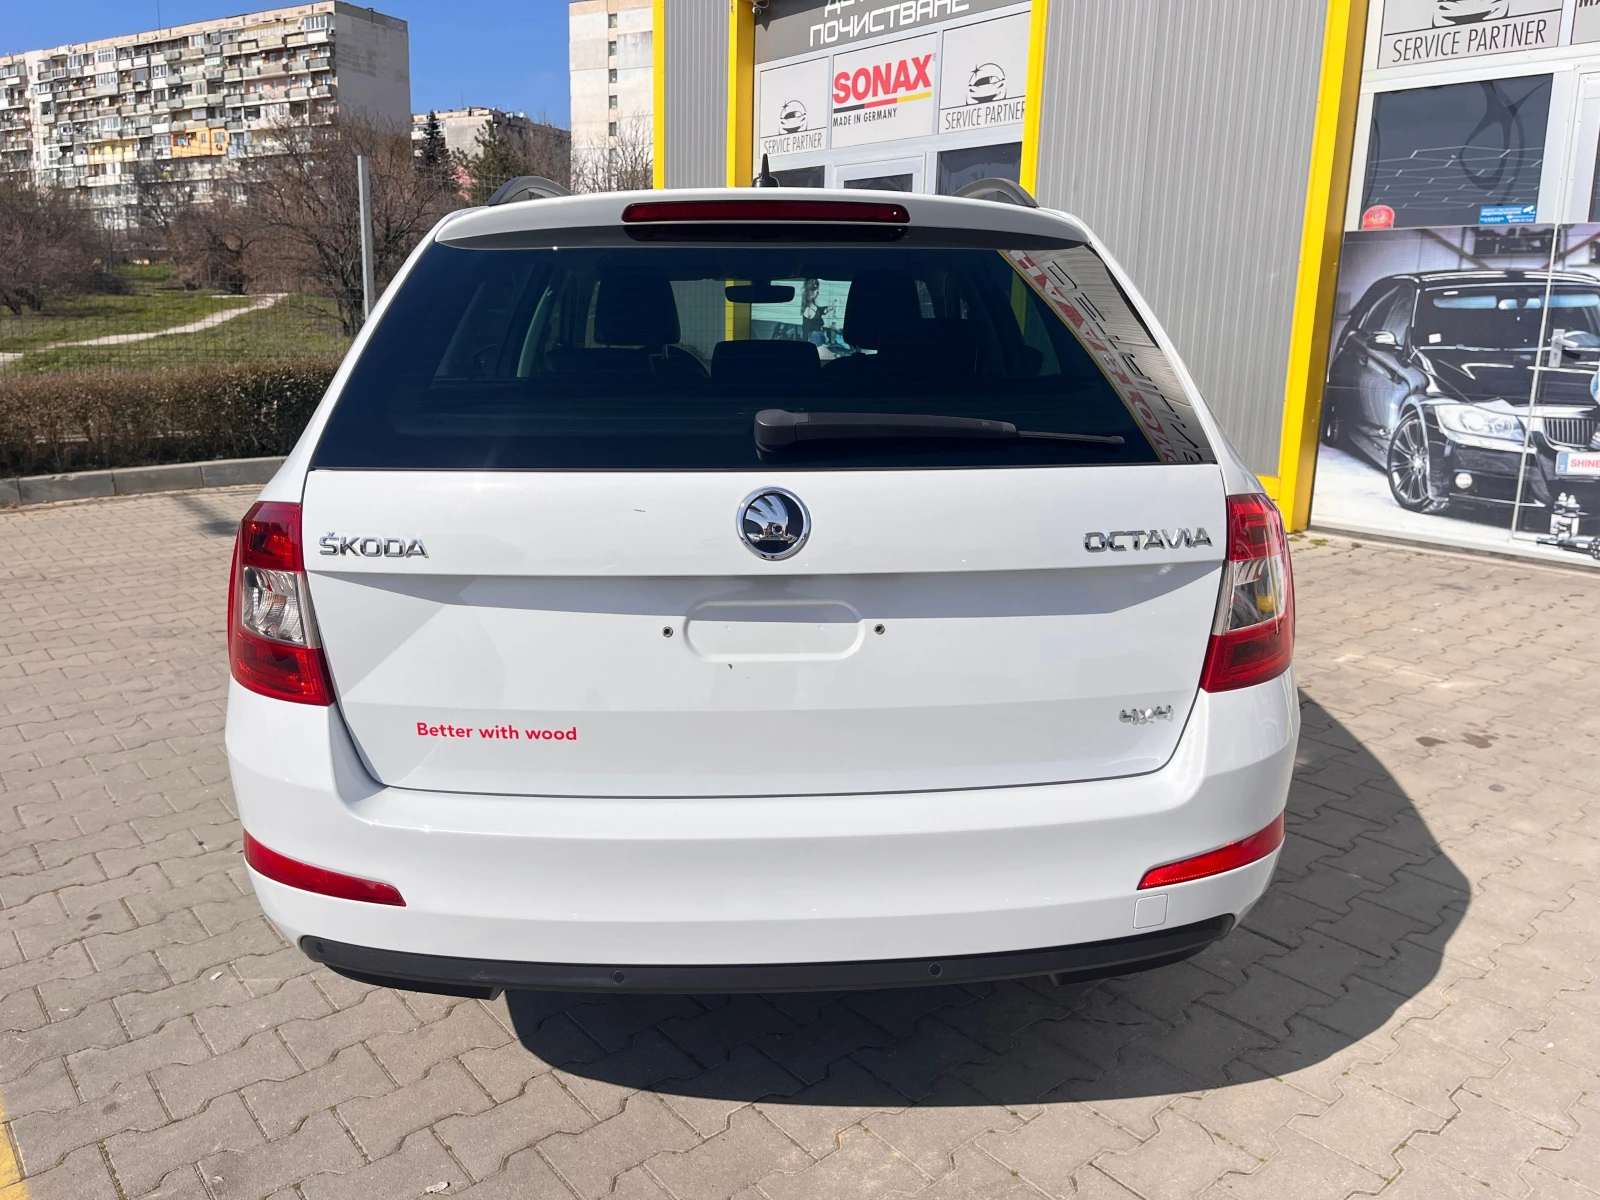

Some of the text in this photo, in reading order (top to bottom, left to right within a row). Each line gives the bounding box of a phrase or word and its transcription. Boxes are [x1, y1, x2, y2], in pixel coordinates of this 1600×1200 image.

[1392, 19, 1547, 63] SERVICE PARTNER
[833, 53, 933, 104] SONAX
[832, 107, 898, 127] MADE IN GERMANY
[945, 103, 982, 130] SERVICE
[764, 132, 823, 154] SERVICE PARTNER
[319, 531, 429, 558] ŠKODA
[1083, 527, 1214, 552] OCTAVIA
[416, 721, 577, 741] Better with wood
